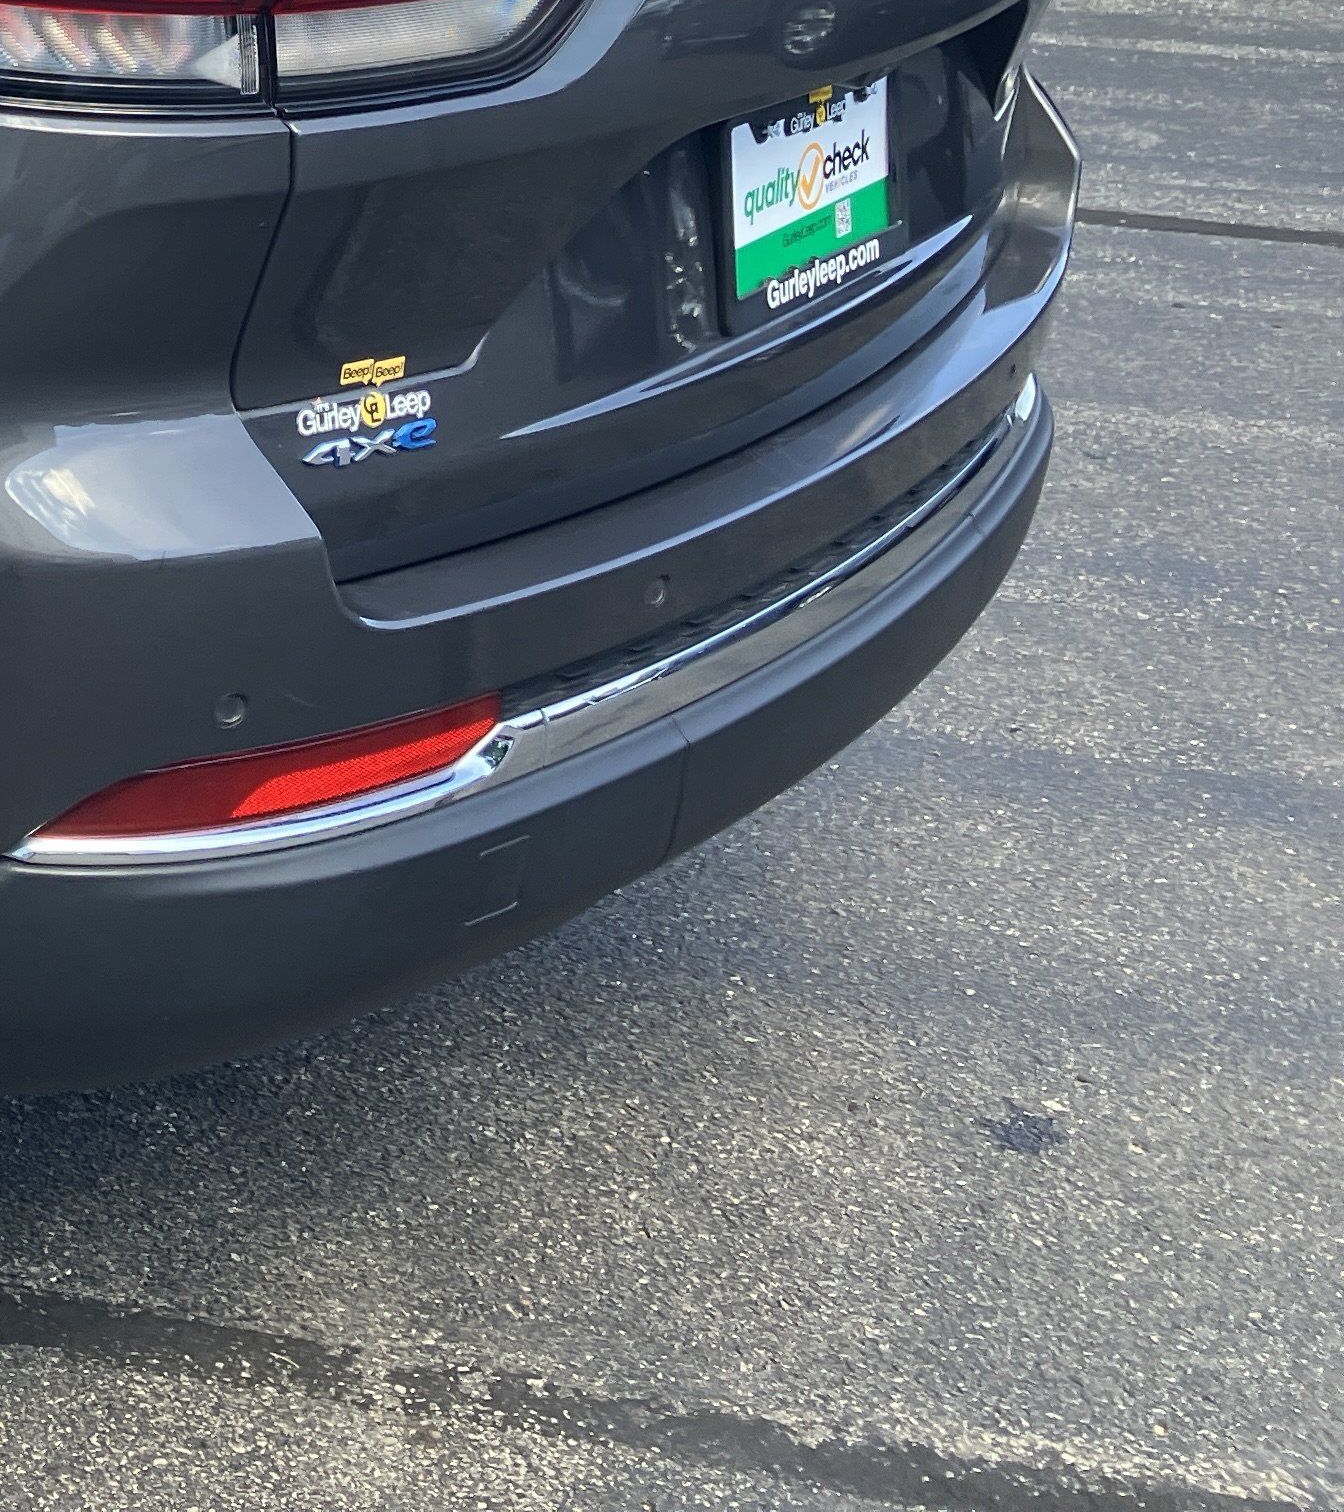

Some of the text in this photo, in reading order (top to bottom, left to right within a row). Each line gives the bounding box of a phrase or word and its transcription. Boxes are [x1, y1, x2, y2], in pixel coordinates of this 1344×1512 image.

[744, 129, 871, 225] quality check
[296, 401, 361, 436] Gurley
[385, 389, 431, 420] Leep
